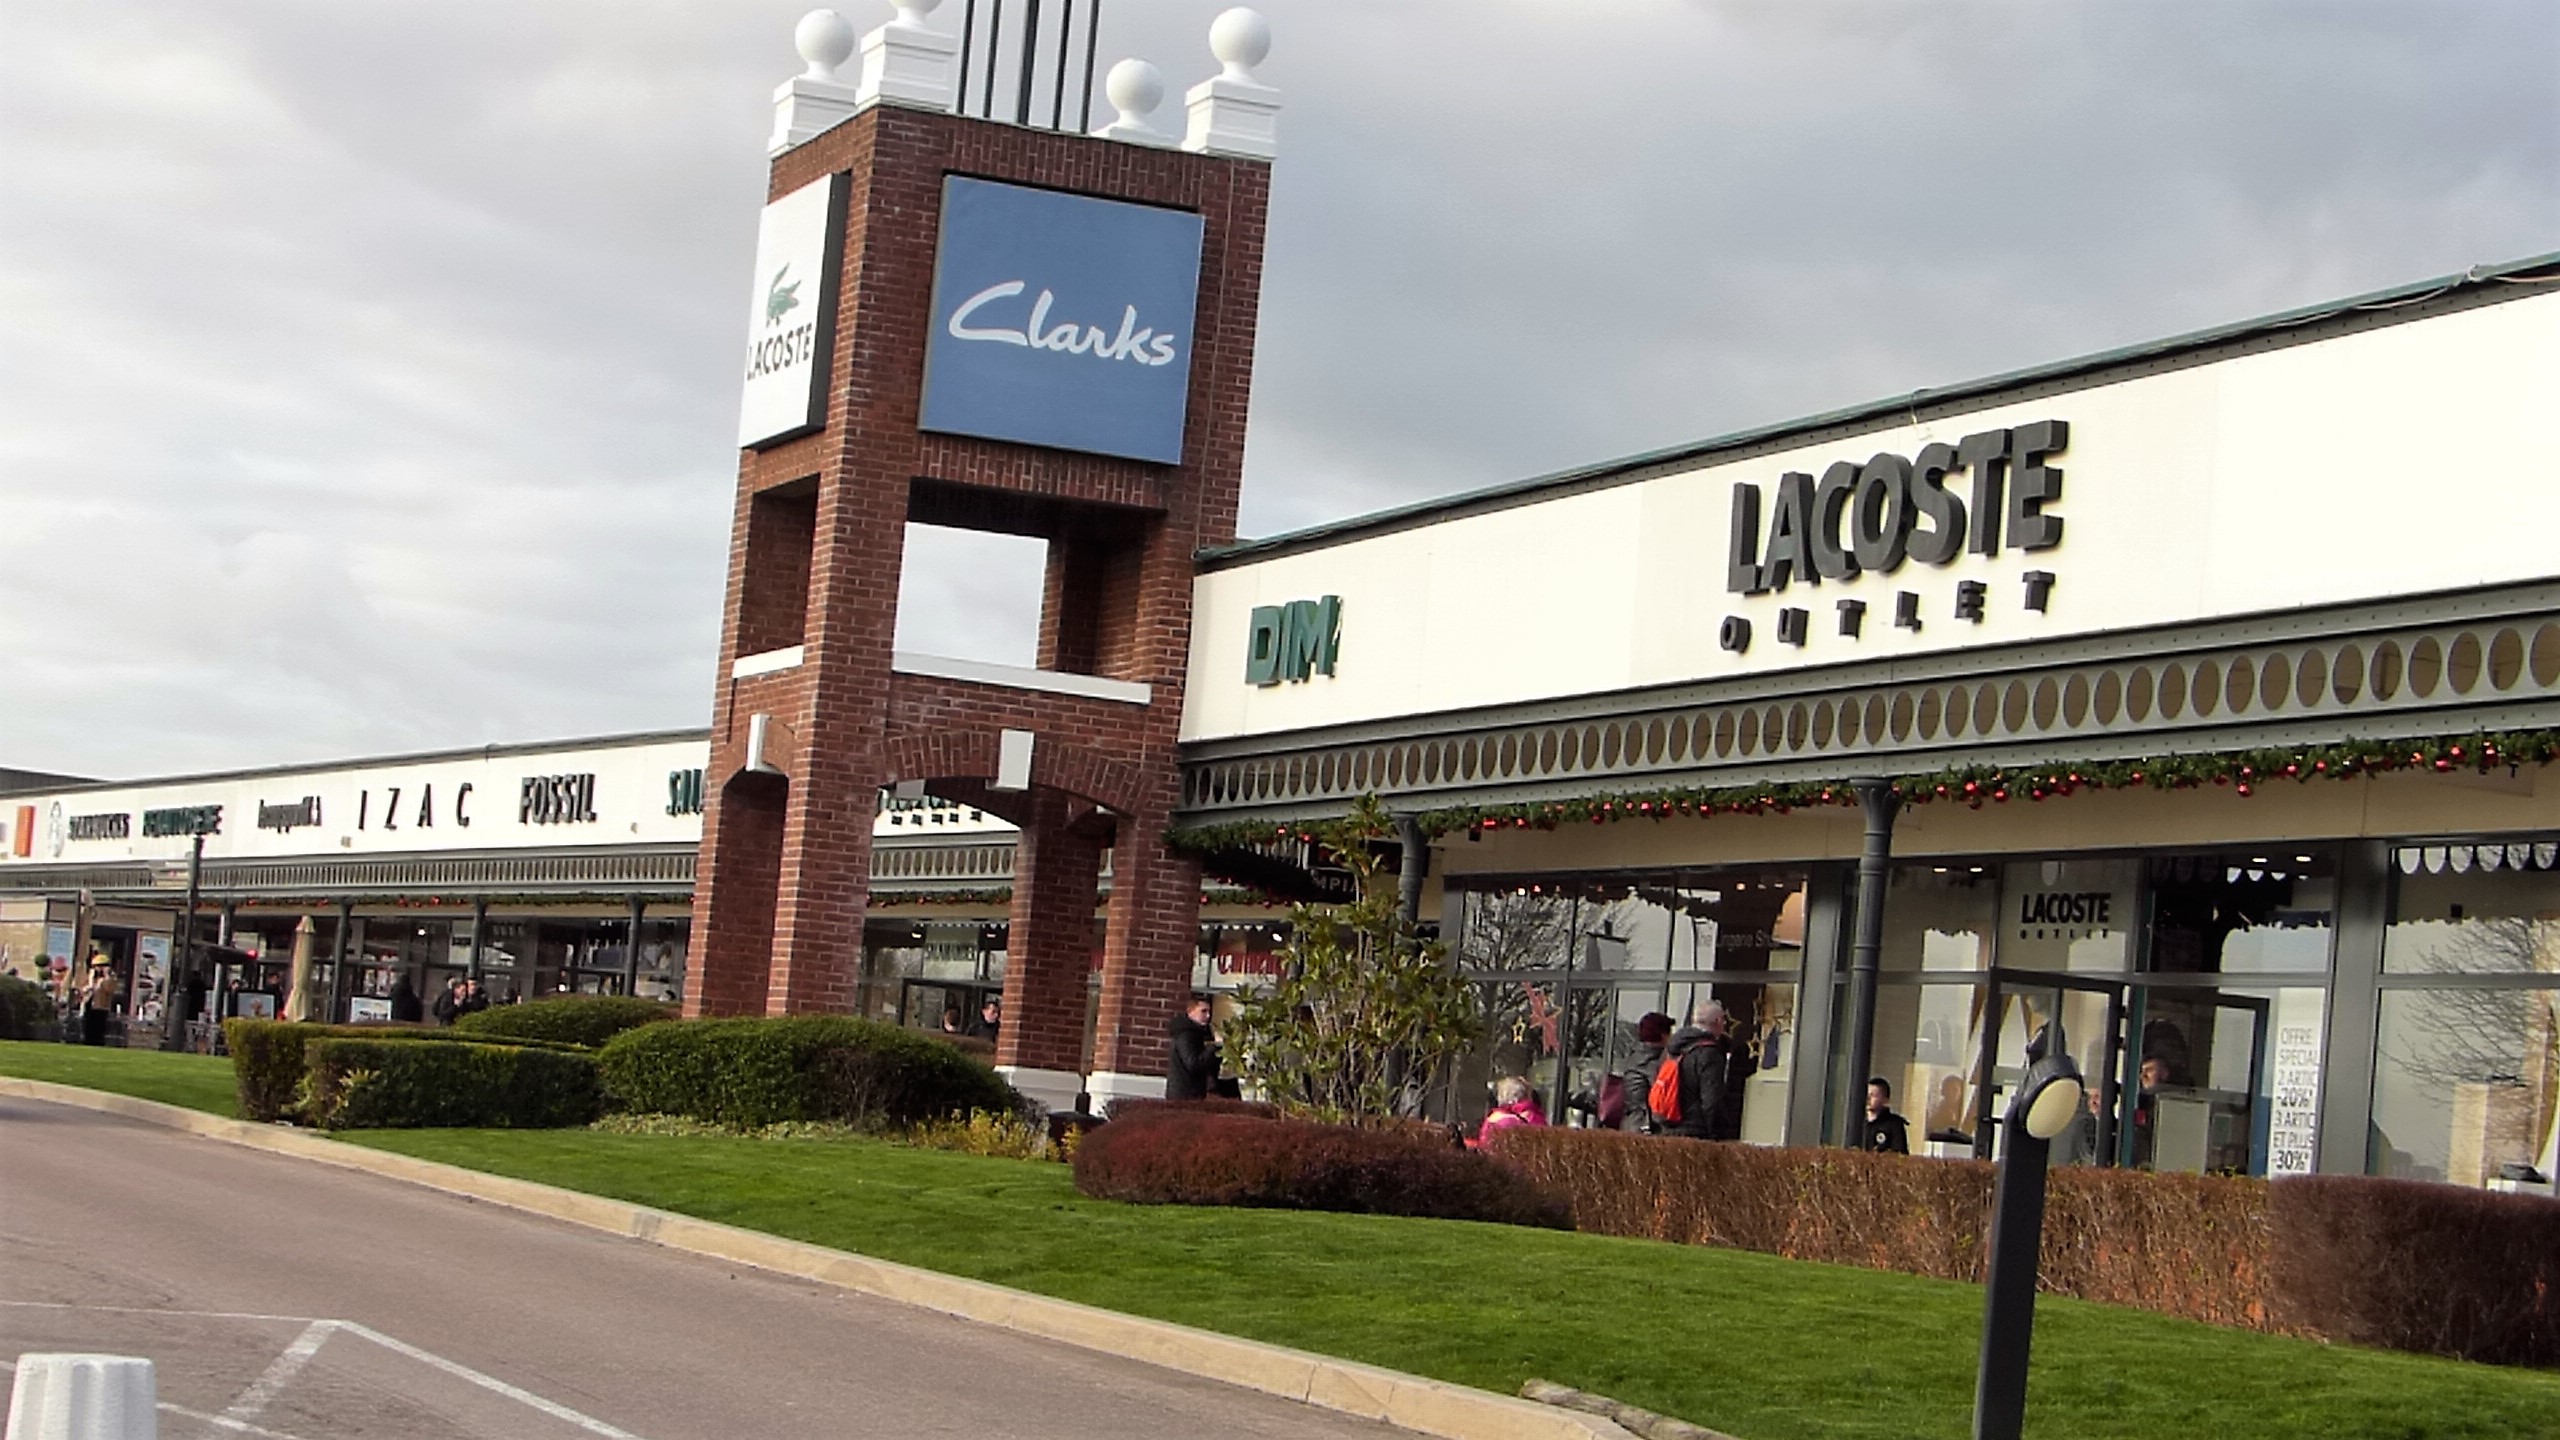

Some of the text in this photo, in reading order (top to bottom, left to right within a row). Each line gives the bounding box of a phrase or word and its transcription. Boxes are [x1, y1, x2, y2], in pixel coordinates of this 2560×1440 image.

[747, 322, 812, 381] LACOSTE
[948, 280, 1175, 367] Clarks
[1727, 419, 2070, 594] LACOSTE
[1245, 595, 1342, 688] DIM
[1720, 570, 2056, 653] OUTLET
[518, 773, 598, 825] FOSSIL
[2019, 928, 2108, 940] OUTLET
[2021, 892, 2112, 924] LACOSTE
